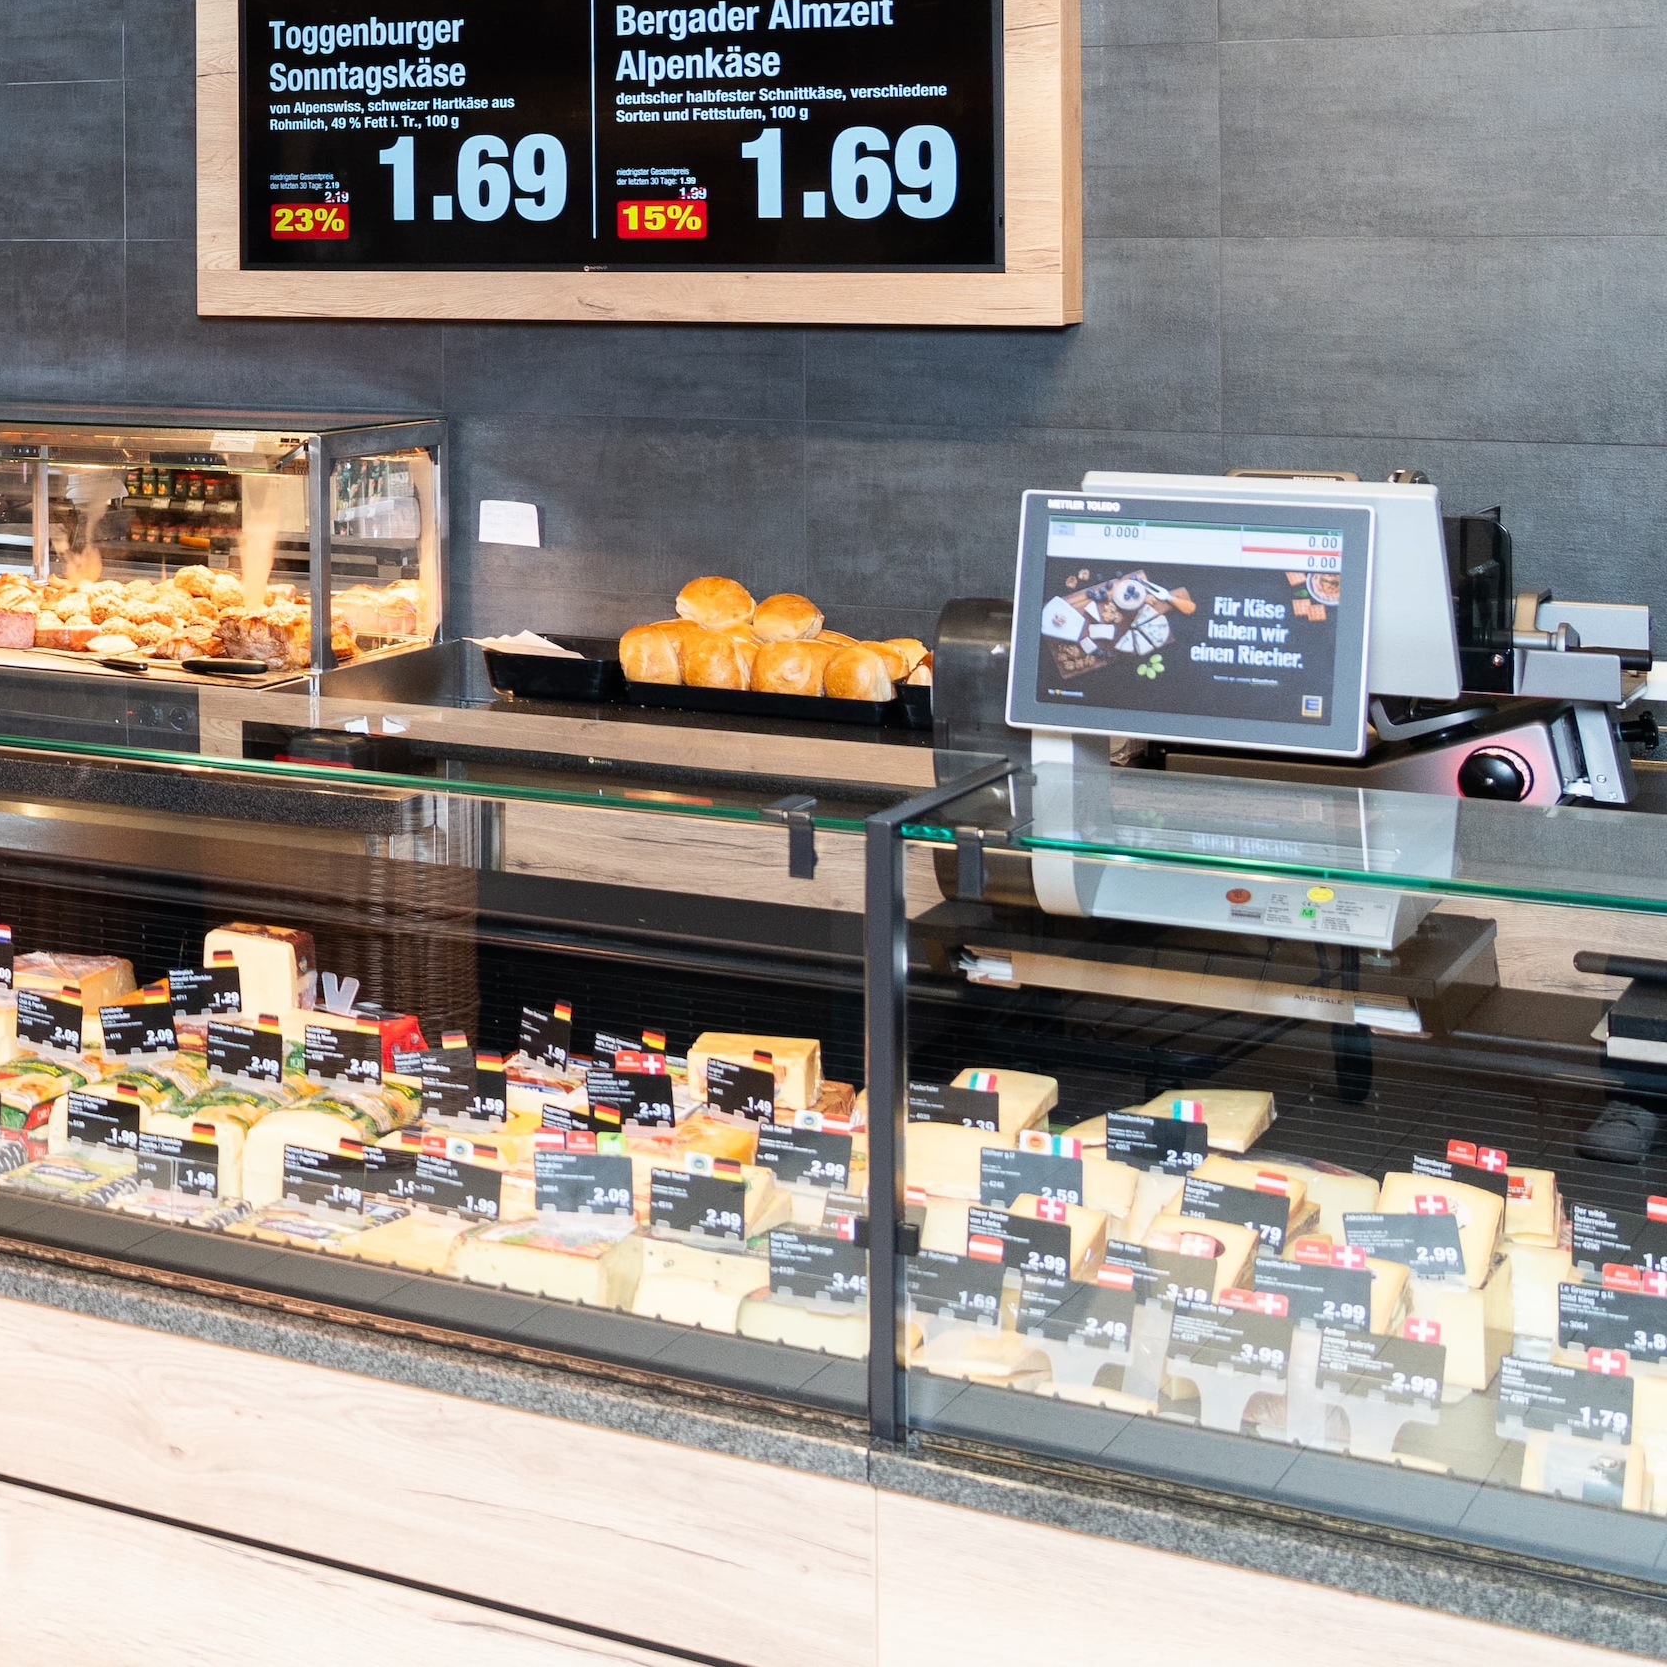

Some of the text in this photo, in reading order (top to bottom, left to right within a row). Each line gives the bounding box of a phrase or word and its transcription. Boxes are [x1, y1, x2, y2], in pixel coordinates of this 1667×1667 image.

[616, 0, 760, 41] Bergader
[269, 17, 464, 55] Toggenburger
[269, 57, 466, 95] Sonntagskäse
[615, 46, 782, 87] Alpenkäse
[616, 84, 947, 105] deutscher halbfester Schnittkäse, verschiedene
[269, 97, 515, 116] von Alpenswiss, schweizer Hartkäse aus
[615, 106, 808, 123] Sorten und Fettstufen, 100 g
[269, 115, 459, 132] Rohmilch, 49 % Fett i. Tr., 100 g
[379, 133, 567, 222] 1.69
[680, 176, 696, 185] 1.99
[741, 125, 957, 220] 1.69
[325, 181, 340, 189] 2.19
[273, 208, 345, 232] 23%
[621, 205, 702, 231] 15%
[1104, 526, 1139, 538] 0.000
[1308, 536, 1338, 548] 0.00
[1306, 555, 1338, 569] 0.00
[1213, 596, 1286, 620] Für Käse
[1207, 618, 1290, 644] haben wir
[1190, 643, 1304, 669] einen Riecher.
[213, 992, 240, 1005] 1.29
[473, 1096, 504, 1111] 1.59
[1167, 1150, 1203, 1166] 2.39
[810, 1160, 845, 1177] 2.99
[465, 1195, 497, 1215] 1.99
[706, 1208, 741, 1226] 2.89
[1028, 1252, 1066, 1272] 2.99
[1416, 1247, 1458, 1262] 2.99
[1323, 1301, 1366, 1320] 2.99
[1085, 1317, 1127, 1336] 2.49
[1241, 1343, 1284, 1364] 3.99
[1579, 1406, 1628, 1429] 1.79
